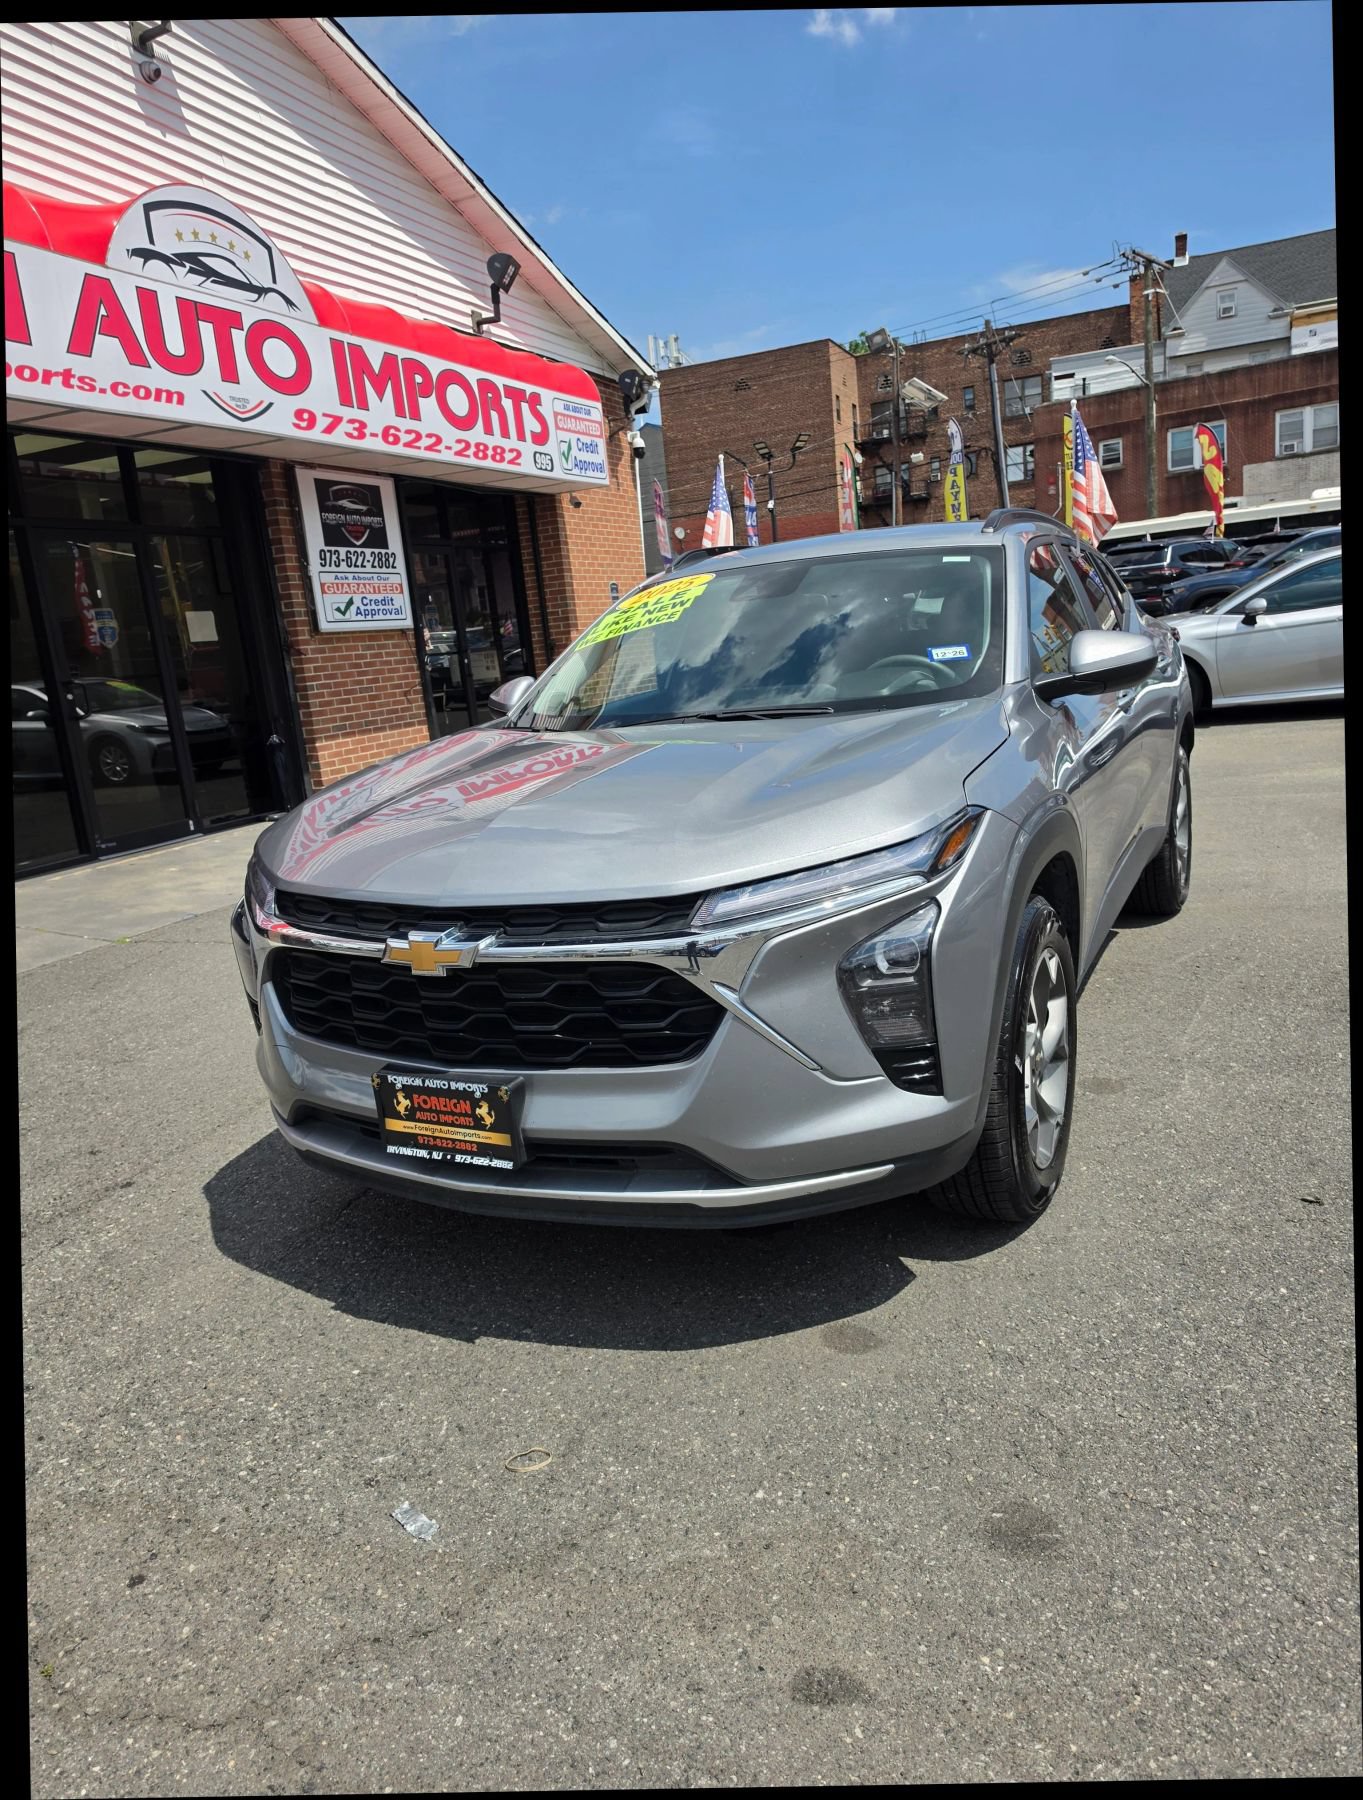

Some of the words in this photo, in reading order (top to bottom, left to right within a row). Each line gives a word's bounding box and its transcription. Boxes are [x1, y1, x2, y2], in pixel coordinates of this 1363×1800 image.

[66, 272, 313, 396] AUTO
[329, 337, 550, 446] IMPORTS
[557, 415, 600, 435] GUARANTEED
[292, 408, 522, 466] 973-622-2882
[576, 438, 599, 455] Credit
[535, 453, 551, 471] 995
[574, 456, 605, 474] Approval
[319, 549, 397, 570] 973-622-2882
[325, 583, 400, 594] GUARANTEED
[361, 596, 395, 606] Credit
[614, 589, 689, 618] SALE
[355, 606, 403, 619] Approval
[590, 613, 638, 635] LIKE
[641, 598, 692, 618] NEW
[578, 633, 602, 648] WE
[604, 610, 681, 638] FINANCE
[387, 1075, 422, 1089] FOREIGN
[425, 1078, 448, 1089] AUTO
[450, 1081, 489, 1097] IMPORTS
[412, 1094, 471, 1114] FOREIGN
[416, 1111, 437, 1122] AUTO
[440, 1114, 474, 1127] IMPORTS
[403, 1125, 492, 1141] www.ForeignAutoImports.com
[418, 1136, 478, 1152] 973-622-2882
[387, 1144, 430, 1160] IRVINGTON,
[432, 1151, 443, 1160] NJ
[455, 1155, 513, 1170] 973-622-2882
